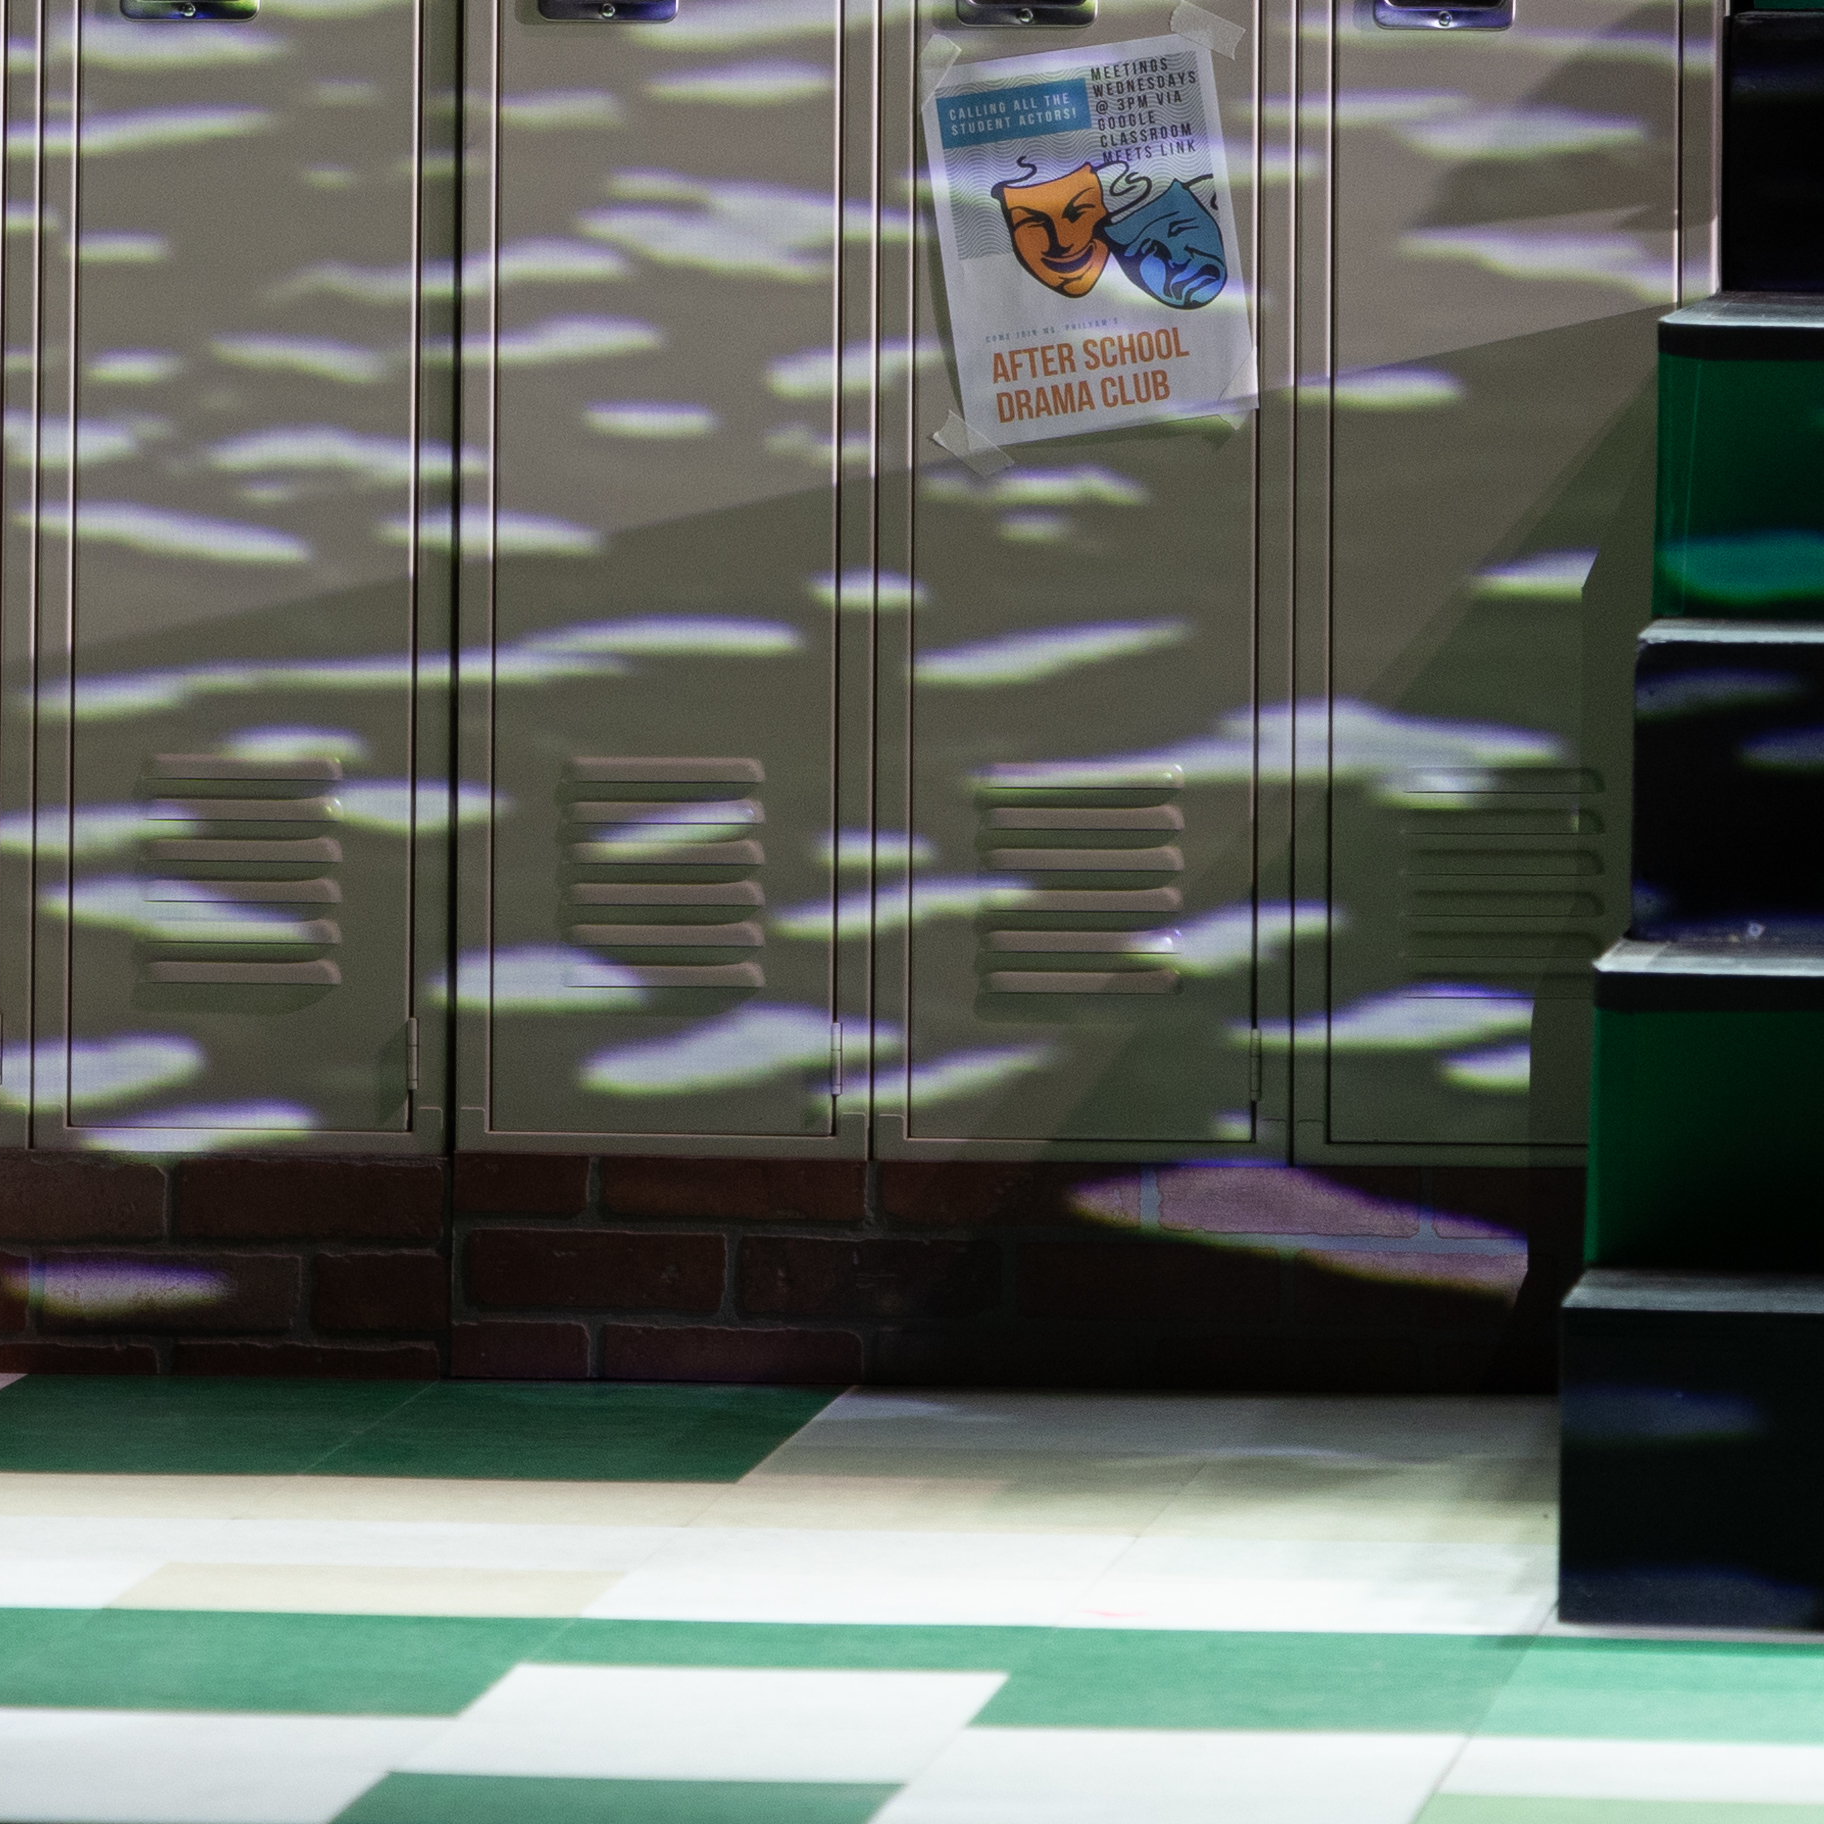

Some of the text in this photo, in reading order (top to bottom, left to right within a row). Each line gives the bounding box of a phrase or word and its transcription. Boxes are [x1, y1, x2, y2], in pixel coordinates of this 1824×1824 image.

[1090, 58, 1168, 81] MEETINGS
[1092, 71, 1196, 97] WEDNESDAYS
[949, 92, 1070, 121] CALLING ALL THE
[1096, 90, 1182, 114] @ 3PM VIA
[951, 116, 1011, 136] STUDENT
[1098, 111, 1155, 131] GOOGLE
[1099, 123, 1192, 148] CLASSROOM
[1102, 139, 1196, 164] MEETS LINK
[993, 327, 1190, 384] AFTER SCHOOL
[996, 369, 1170, 424] DRAMA CLUB
